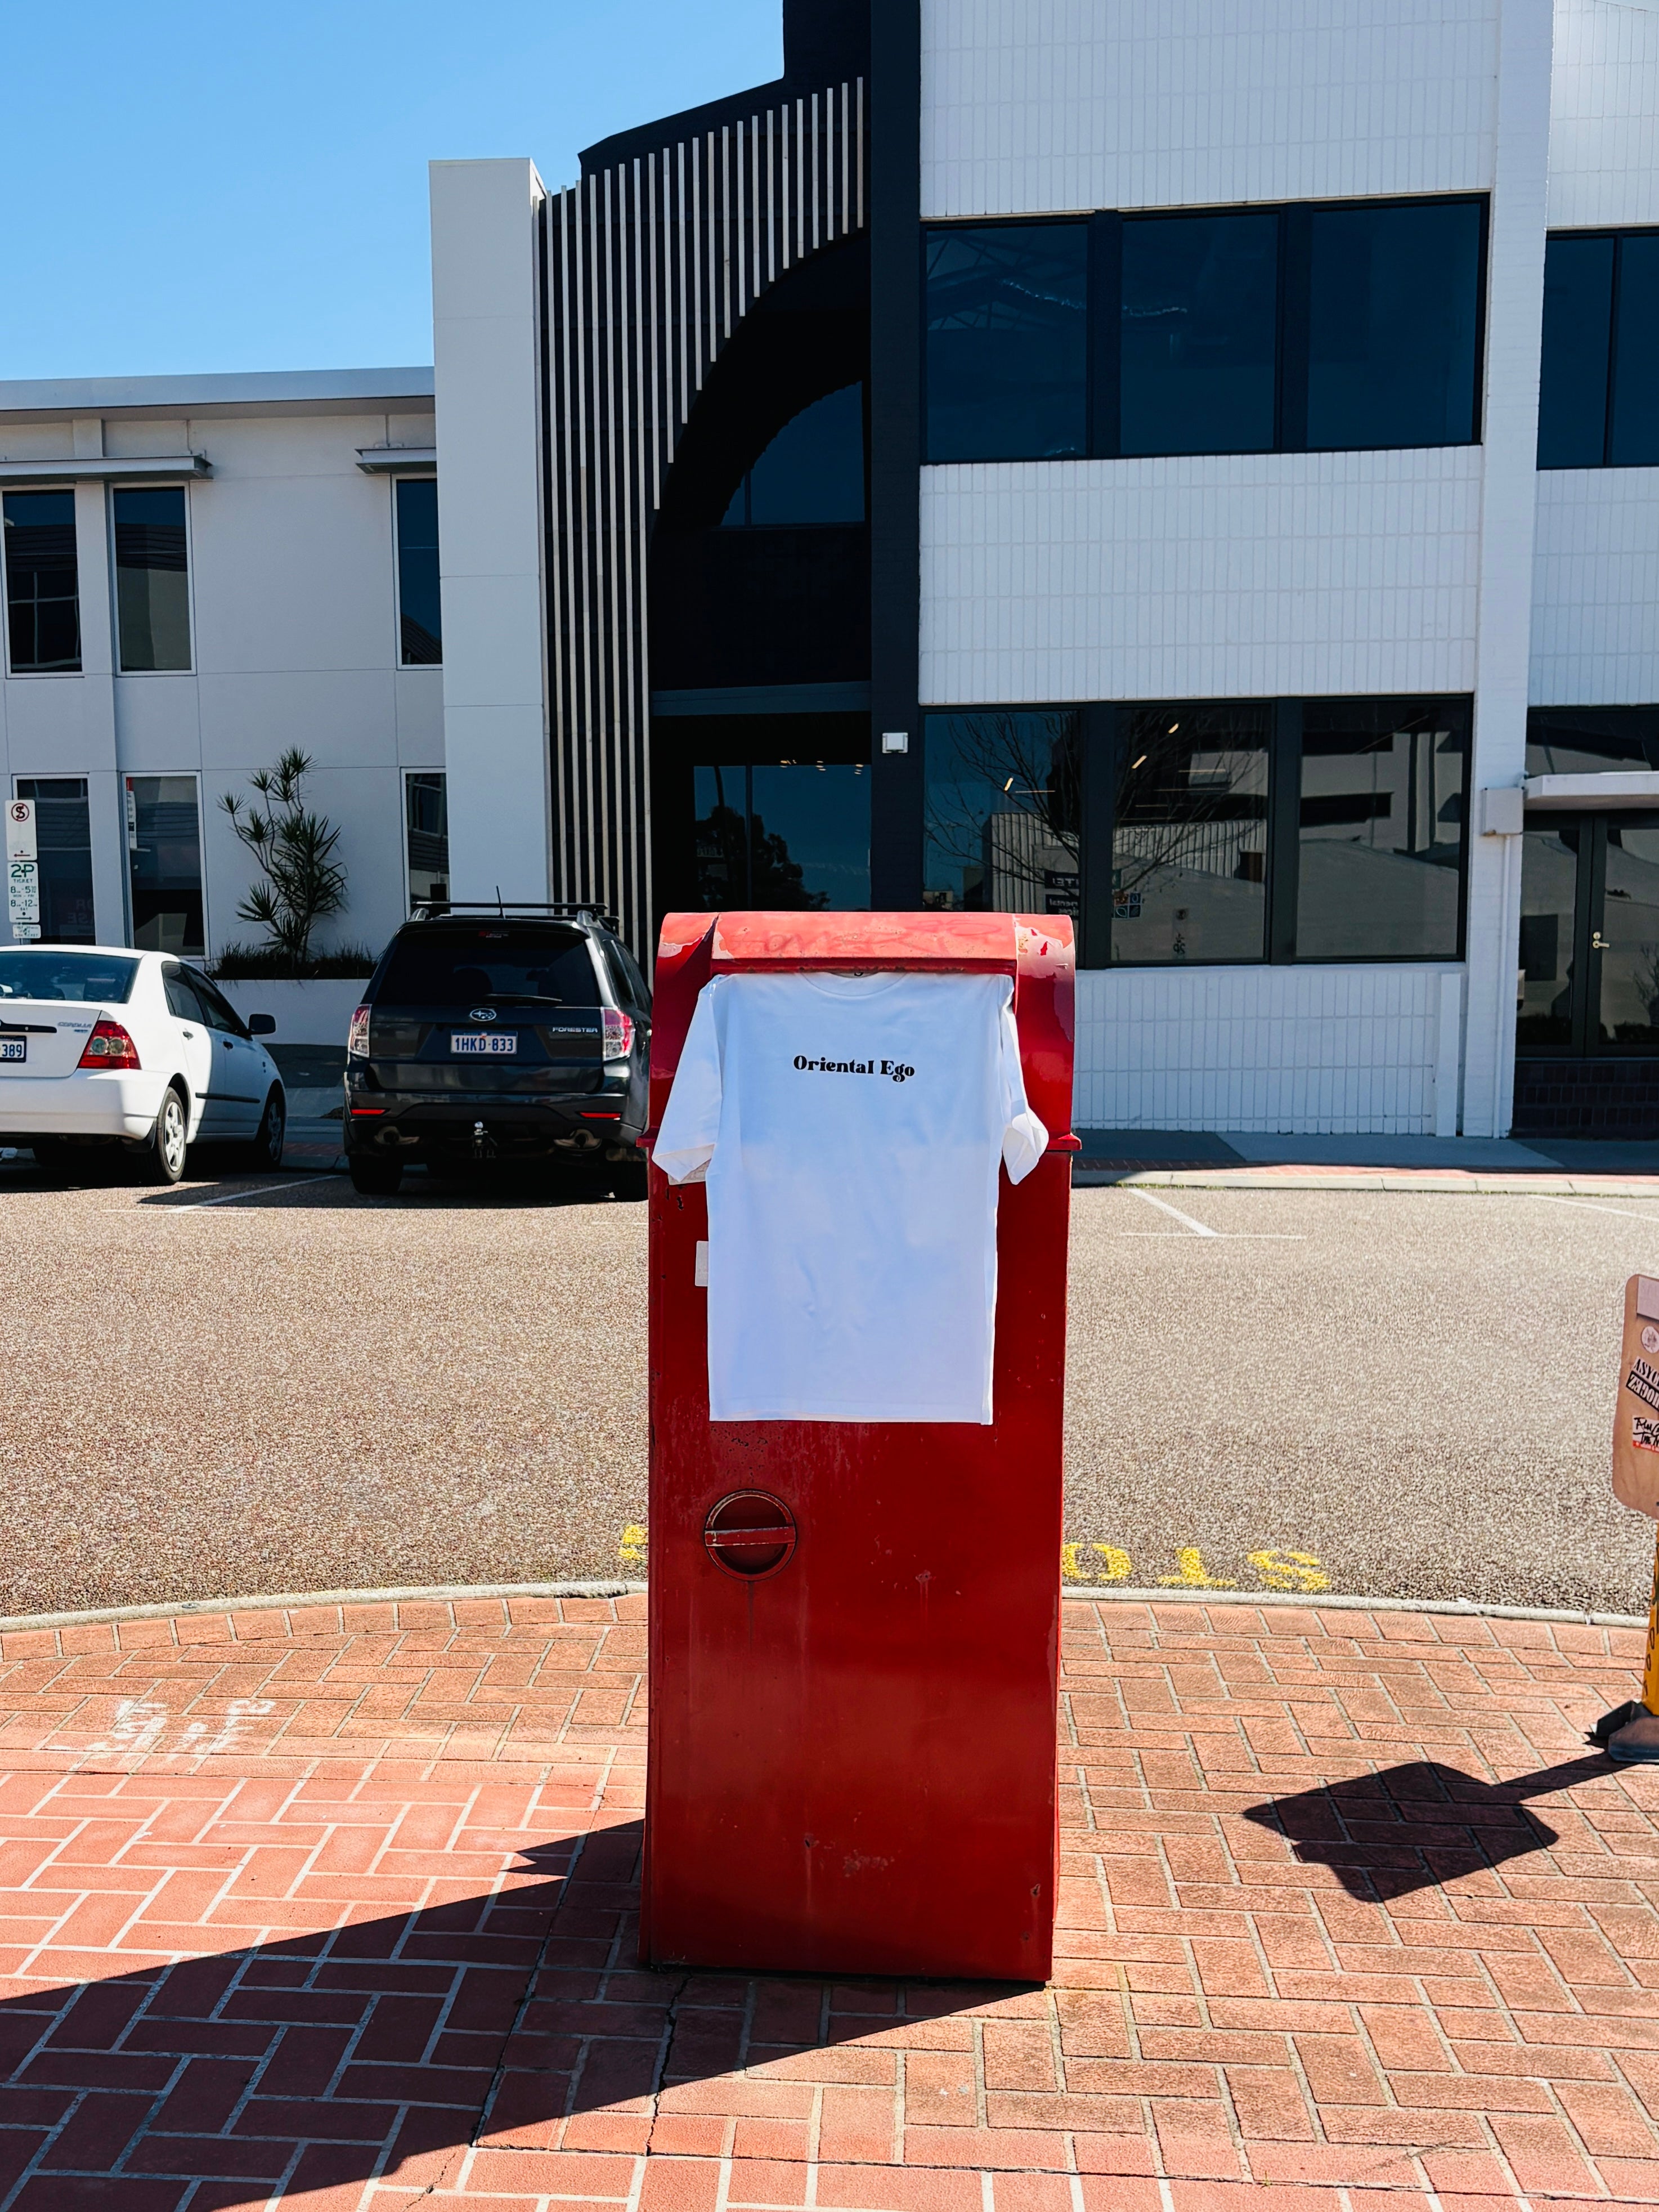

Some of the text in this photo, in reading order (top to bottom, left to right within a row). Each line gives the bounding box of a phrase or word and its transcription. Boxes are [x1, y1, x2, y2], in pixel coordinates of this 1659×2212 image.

[11, 864, 34, 877] 2P
[793, 1055, 915, 1082] Oriental Ego
